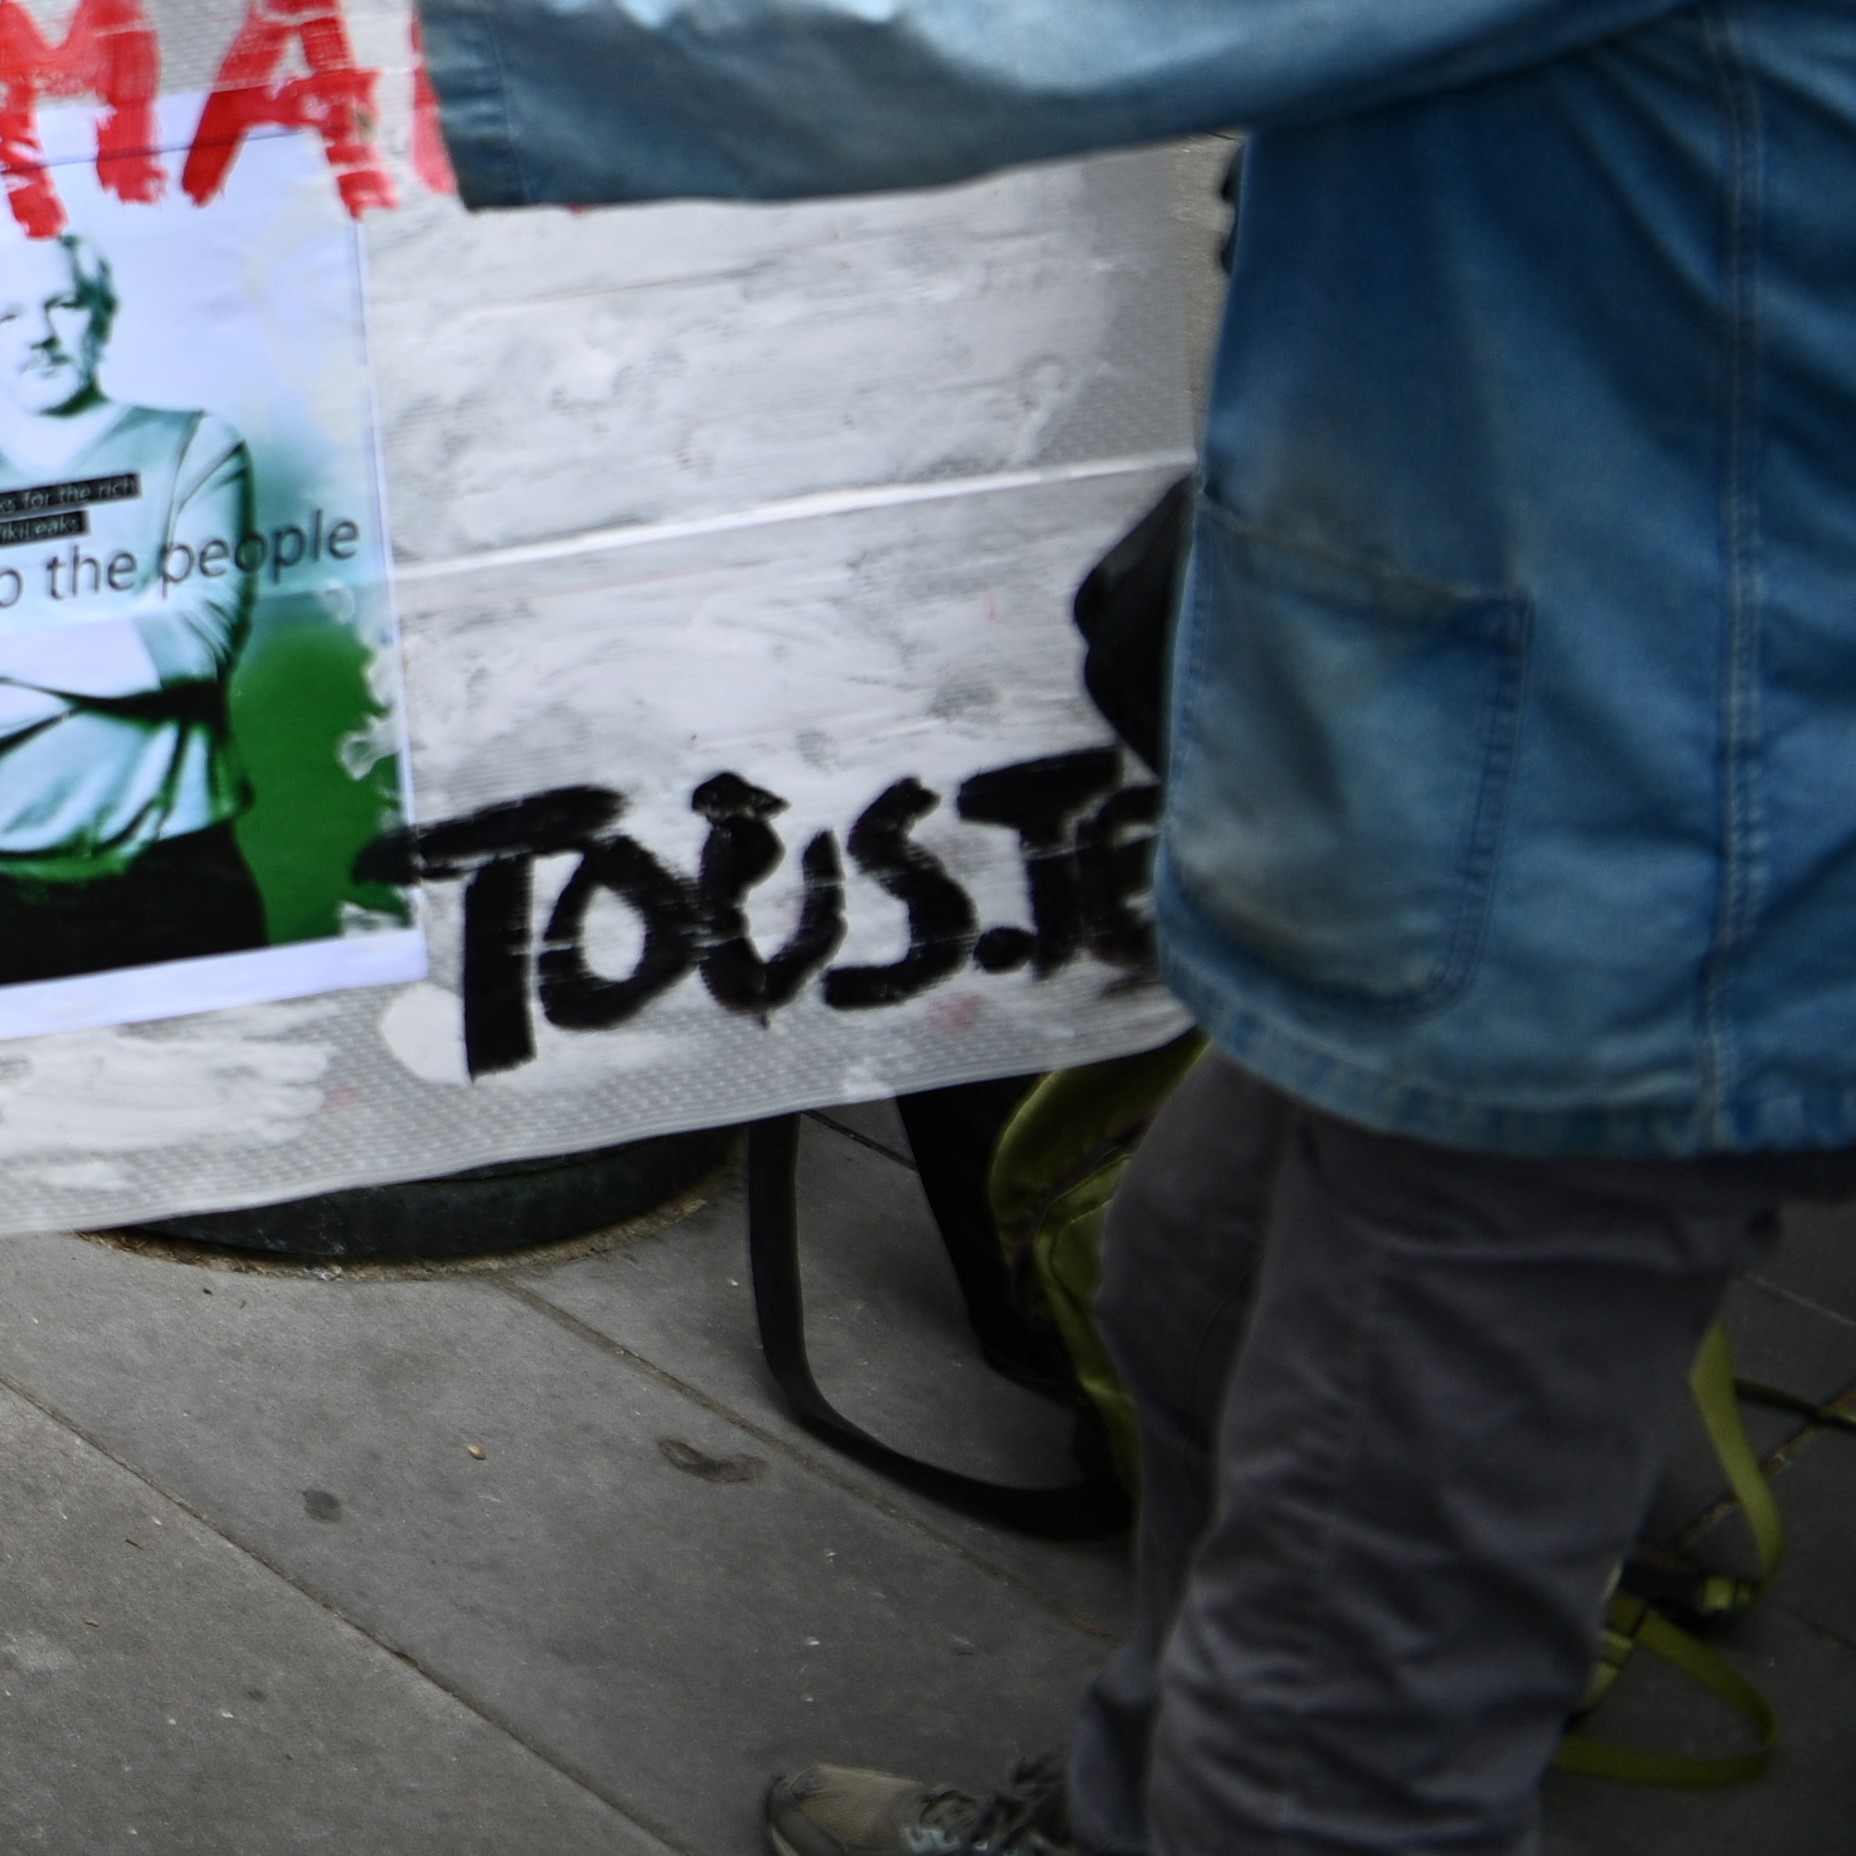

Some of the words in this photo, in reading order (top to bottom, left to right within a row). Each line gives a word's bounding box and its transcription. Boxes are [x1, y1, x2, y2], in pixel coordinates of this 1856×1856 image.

[22, 491, 49, 508] for
[59, 484, 88, 501] the
[45, 545, 137, 601] the
[159, 509, 360, 599] people
